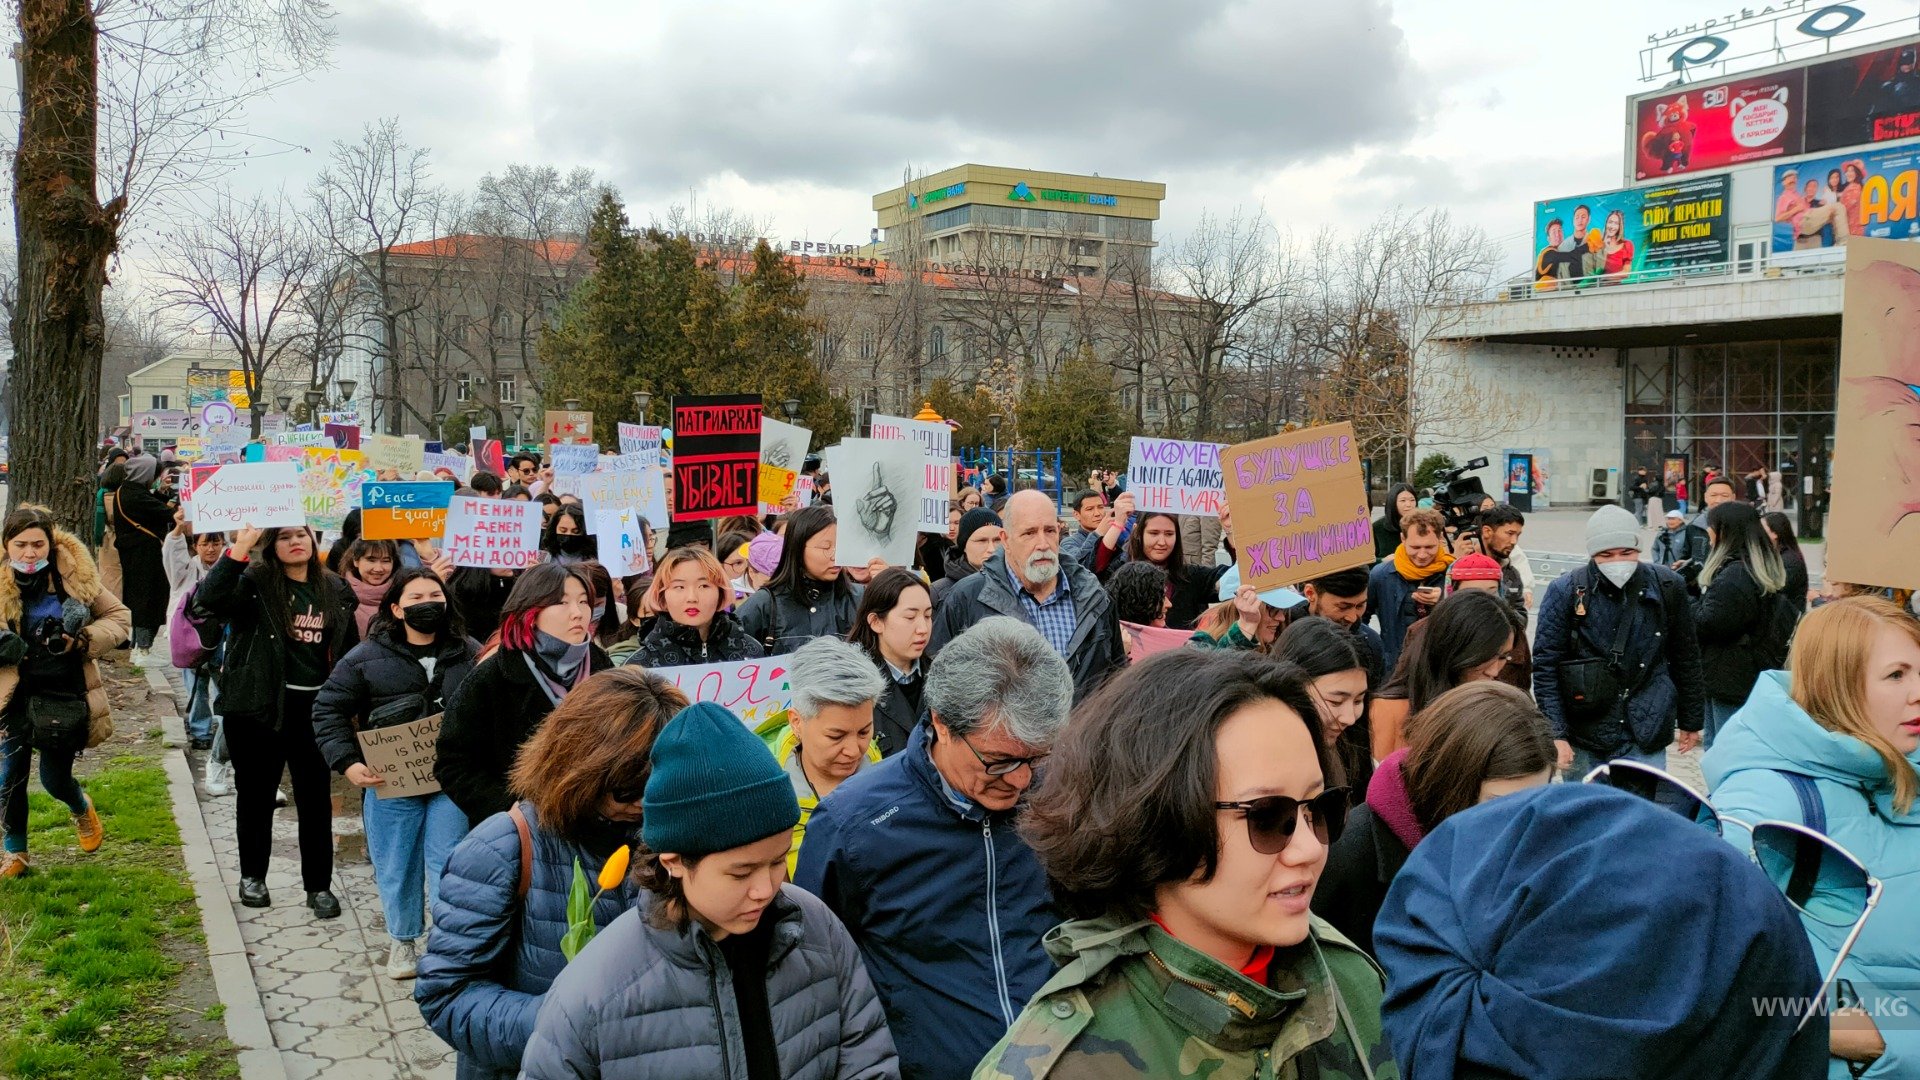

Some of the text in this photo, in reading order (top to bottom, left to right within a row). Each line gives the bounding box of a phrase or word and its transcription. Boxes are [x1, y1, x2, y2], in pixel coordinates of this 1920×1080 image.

[1648, 0, 1811, 43] КИНОТЕАТ
[1703, 86, 1728, 108] 3D
[677, 408, 761, 432] ПАТРИАРХАТ
[1234, 435, 1351, 489] БУДУЩЕЕ
[680, 463, 755, 510] УБИВАЕТ
[1132, 466, 1174, 487] UNITE
[1140, 486, 1172, 508] THE
[1273, 487, 1315, 527] ЗА
[197, 502, 259, 522] Каждый
[392, 505, 434, 525] Equal
[464, 500, 524, 517] МЕНИН
[474, 520, 522, 533] ДЕНЕМ
[454, 534, 521, 548] МЕНИН
[1246, 505, 1371, 578] ЖЕНЩИНОЙ
[447, 547, 538, 566] ТАНДООМ
[362, 732, 402, 747] When
[391, 776, 405, 789] of
[870, 806, 899, 826] TRIBORD
